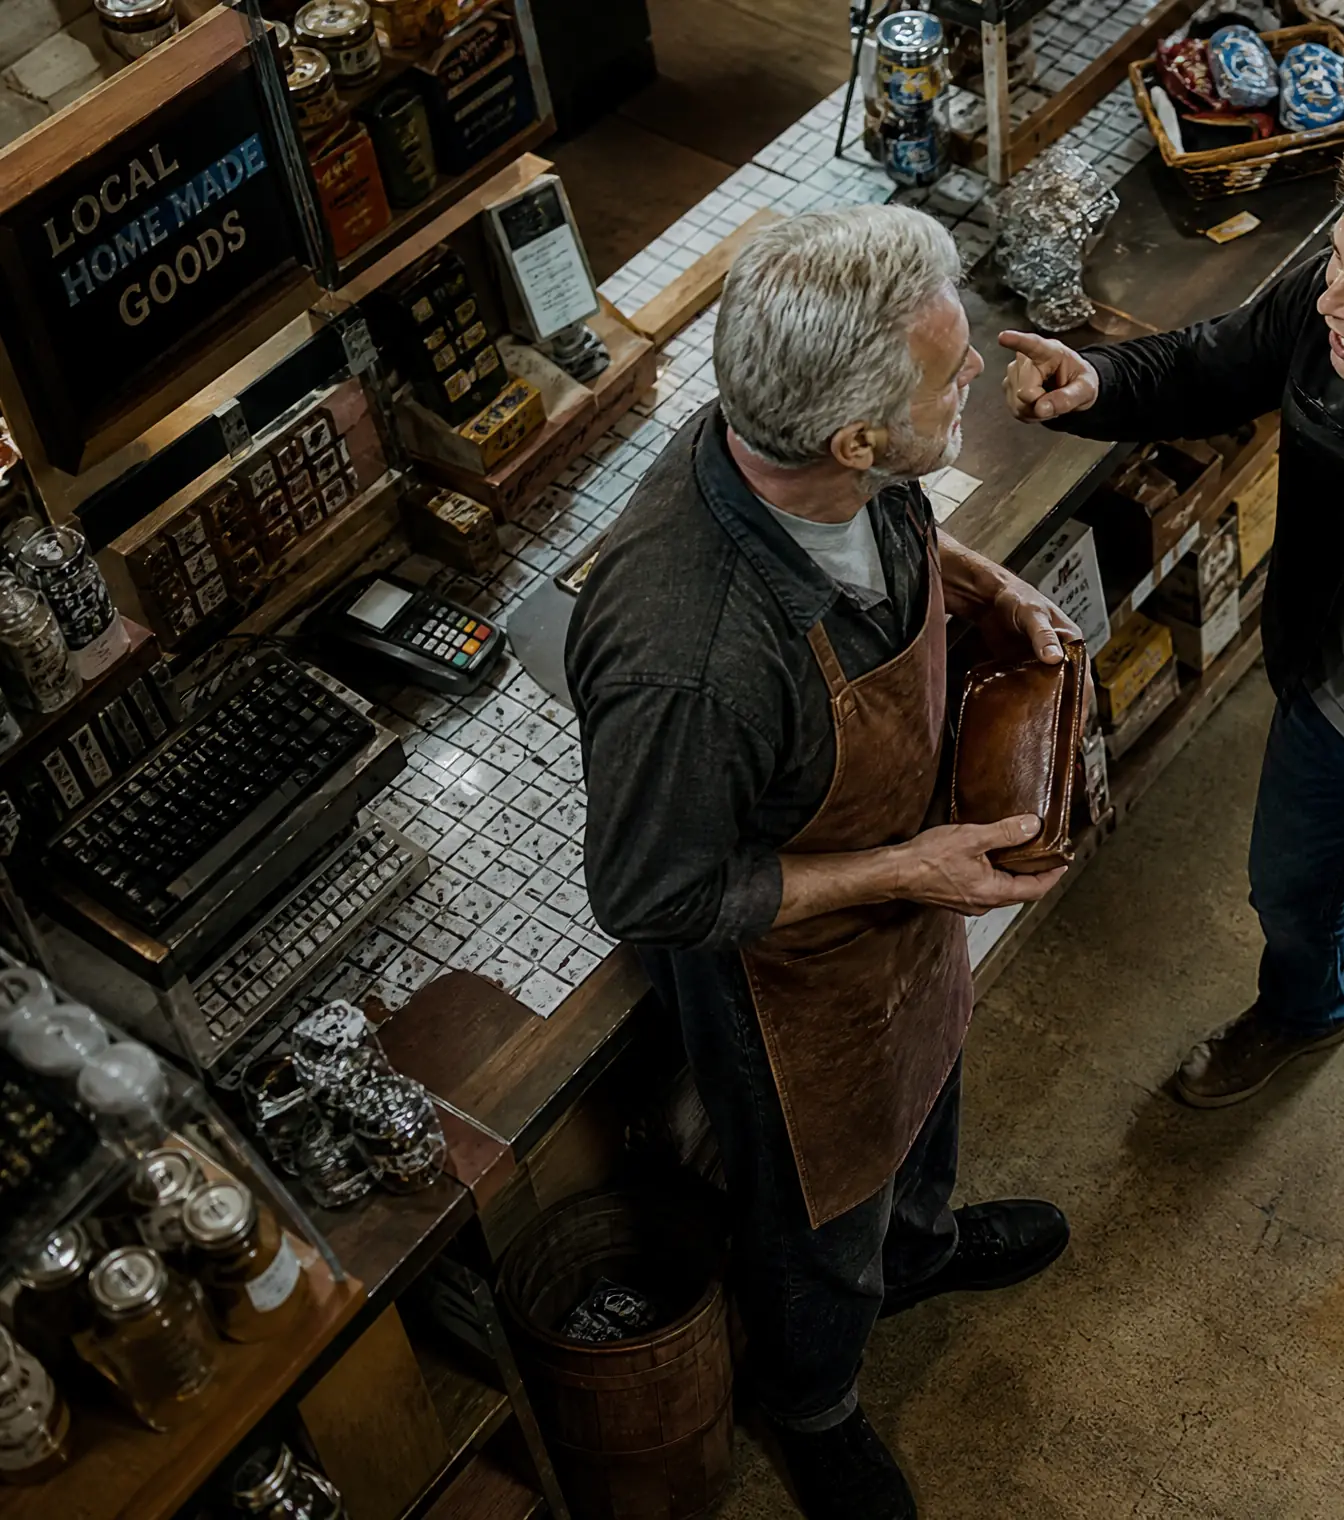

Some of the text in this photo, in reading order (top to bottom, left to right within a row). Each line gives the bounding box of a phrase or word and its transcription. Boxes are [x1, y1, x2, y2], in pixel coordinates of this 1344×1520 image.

[42, 143, 180, 259] LOCAL
[60, 206, 169, 308] HOME
[168, 134, 267, 229] MADE
[119, 209, 247, 327] GOODS
